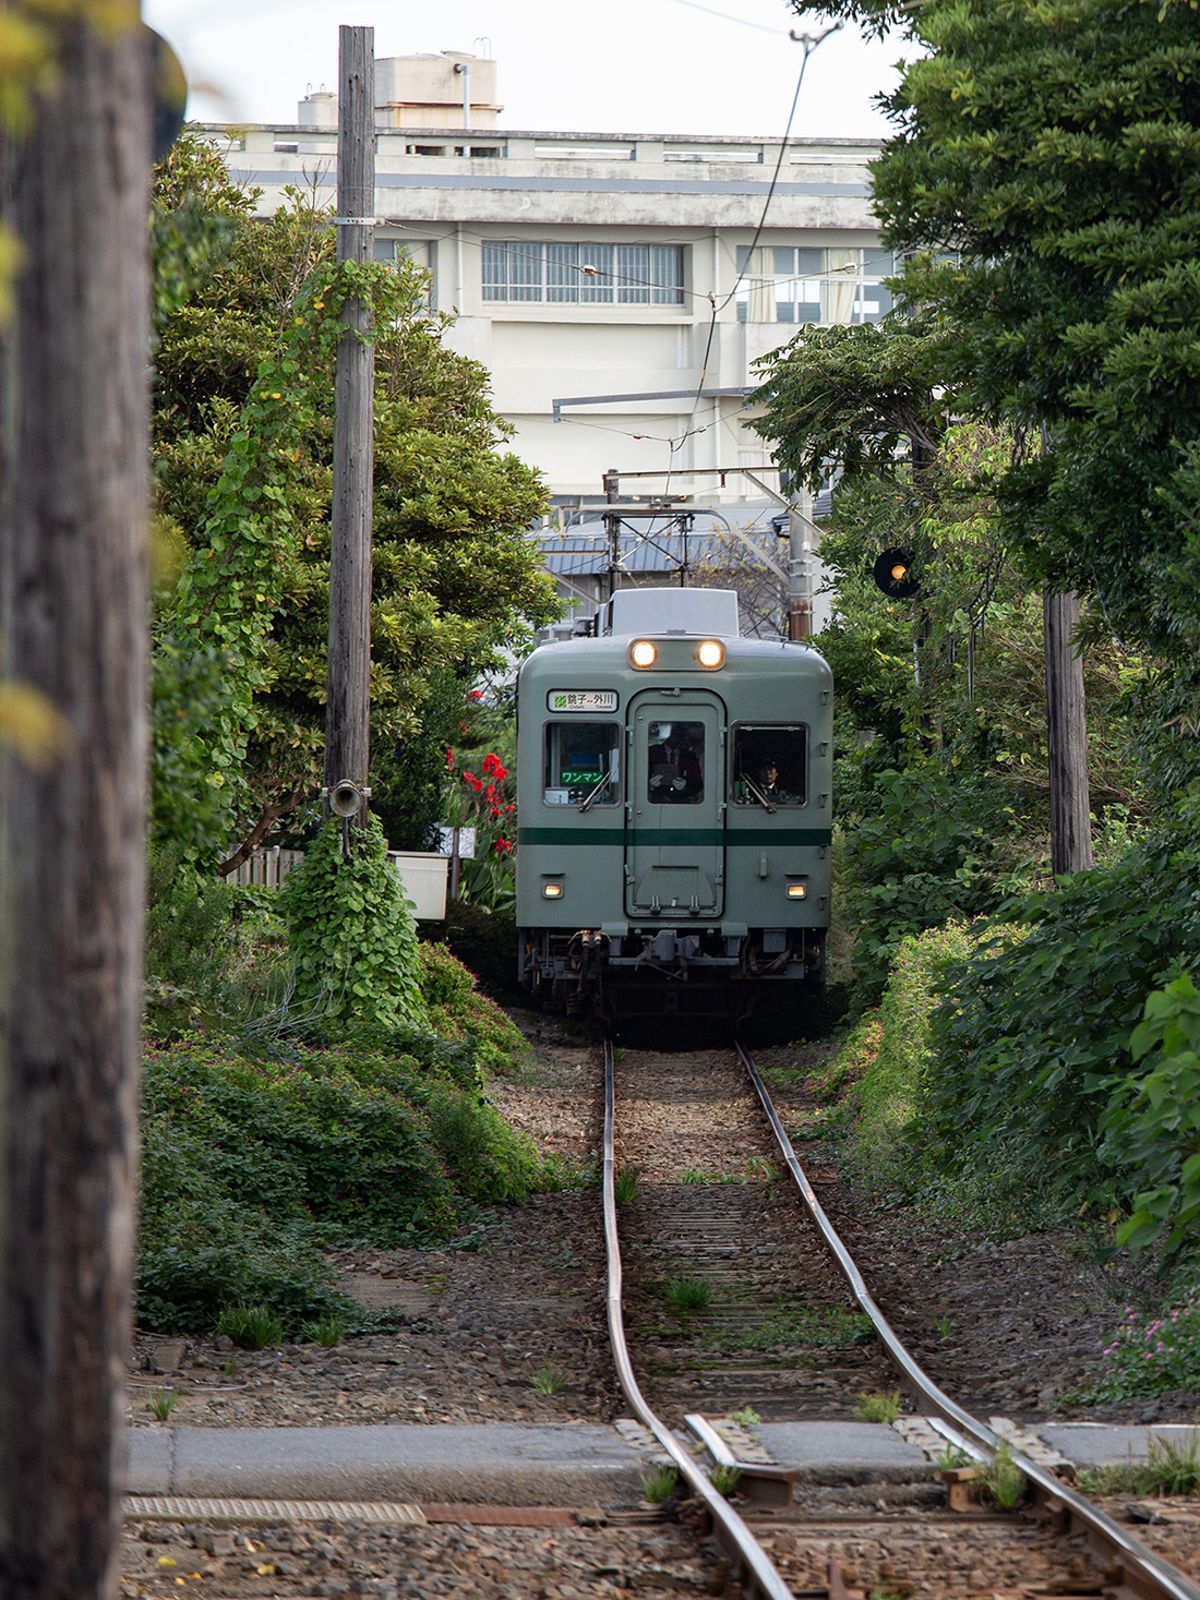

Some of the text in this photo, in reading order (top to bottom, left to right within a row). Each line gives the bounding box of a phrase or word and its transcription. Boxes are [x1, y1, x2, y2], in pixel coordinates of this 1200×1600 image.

[594, 694, 613, 704] 外川
[562, 772, 602, 783] ワンマン
